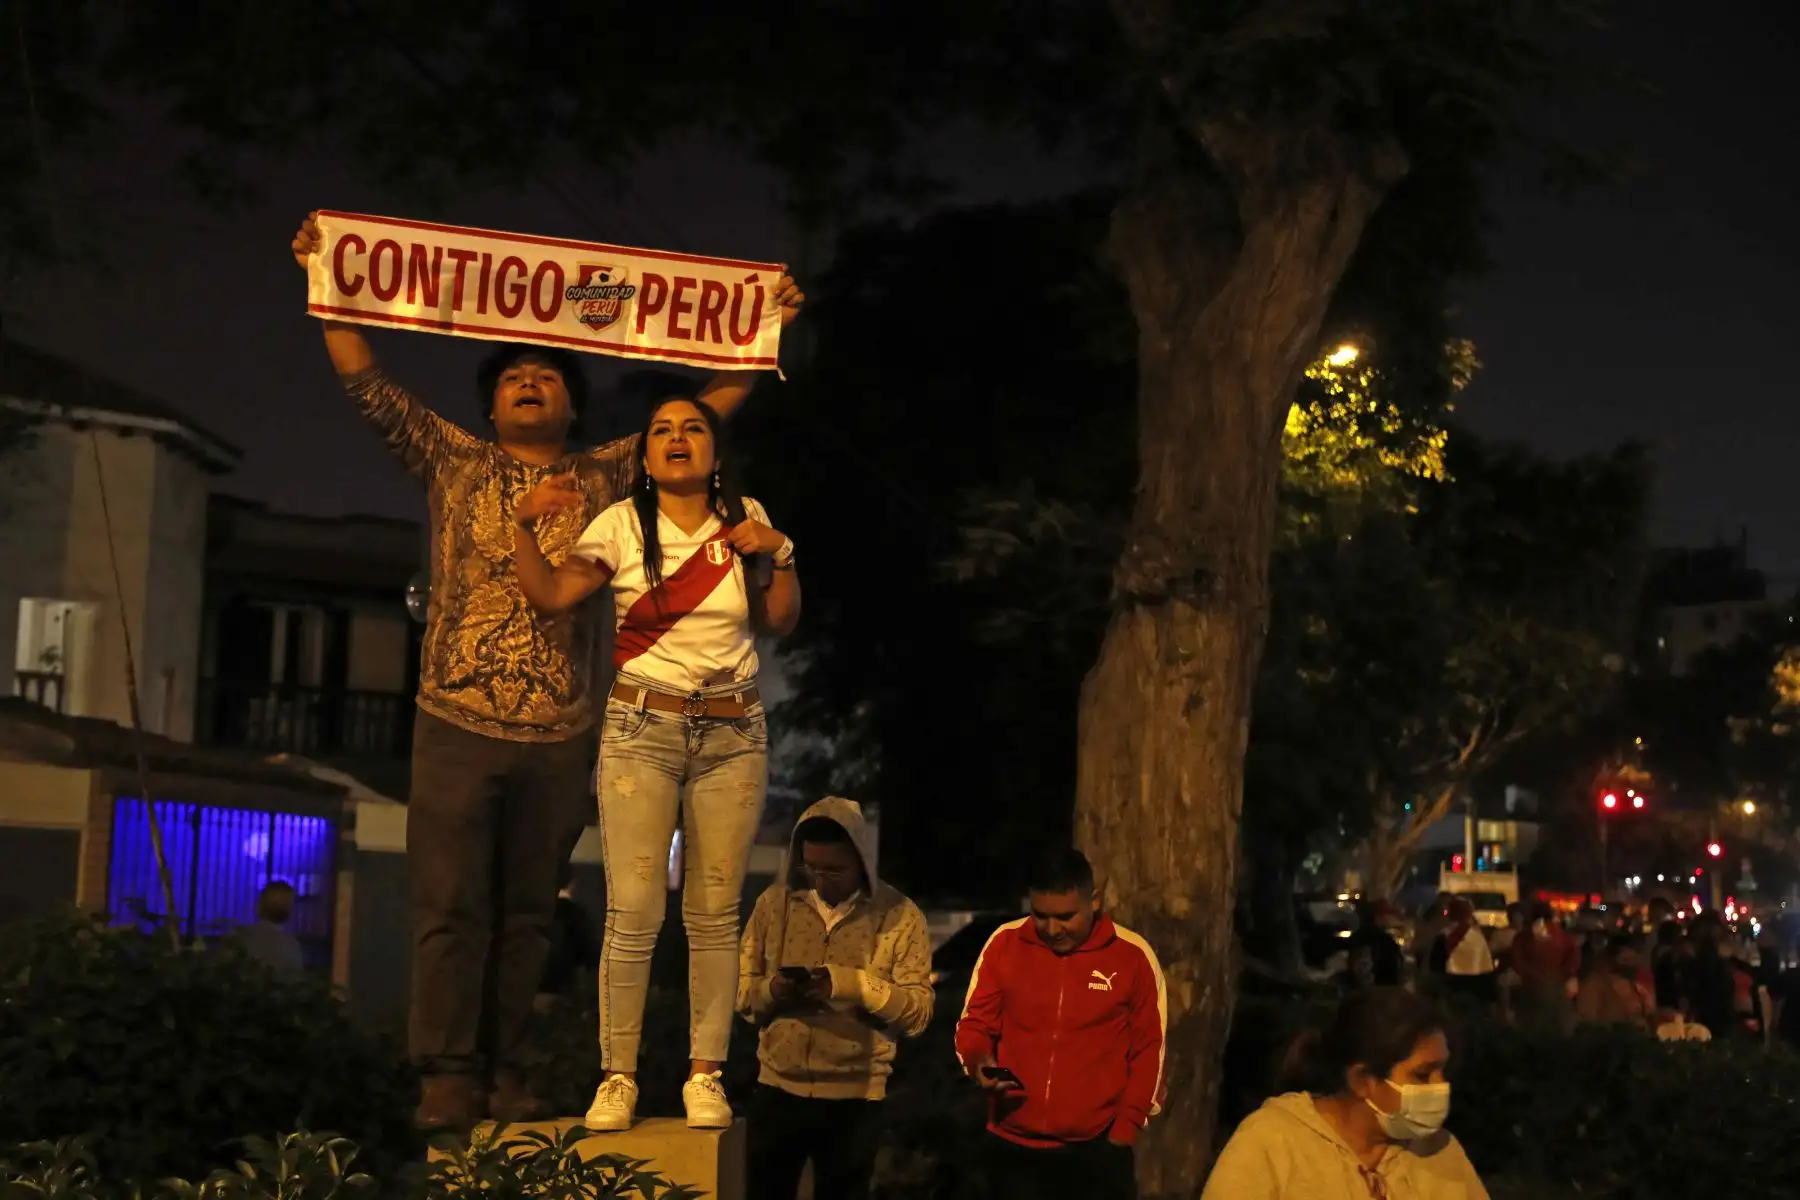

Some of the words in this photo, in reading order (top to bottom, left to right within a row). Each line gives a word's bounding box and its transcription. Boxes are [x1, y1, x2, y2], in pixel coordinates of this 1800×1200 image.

[333, 233, 565, 323] CONTIGO
[635, 272, 765, 347] PERÚ
[565, 286, 635, 300] COMUNIDAD
[1088, 982, 1108, 991] PUMA
